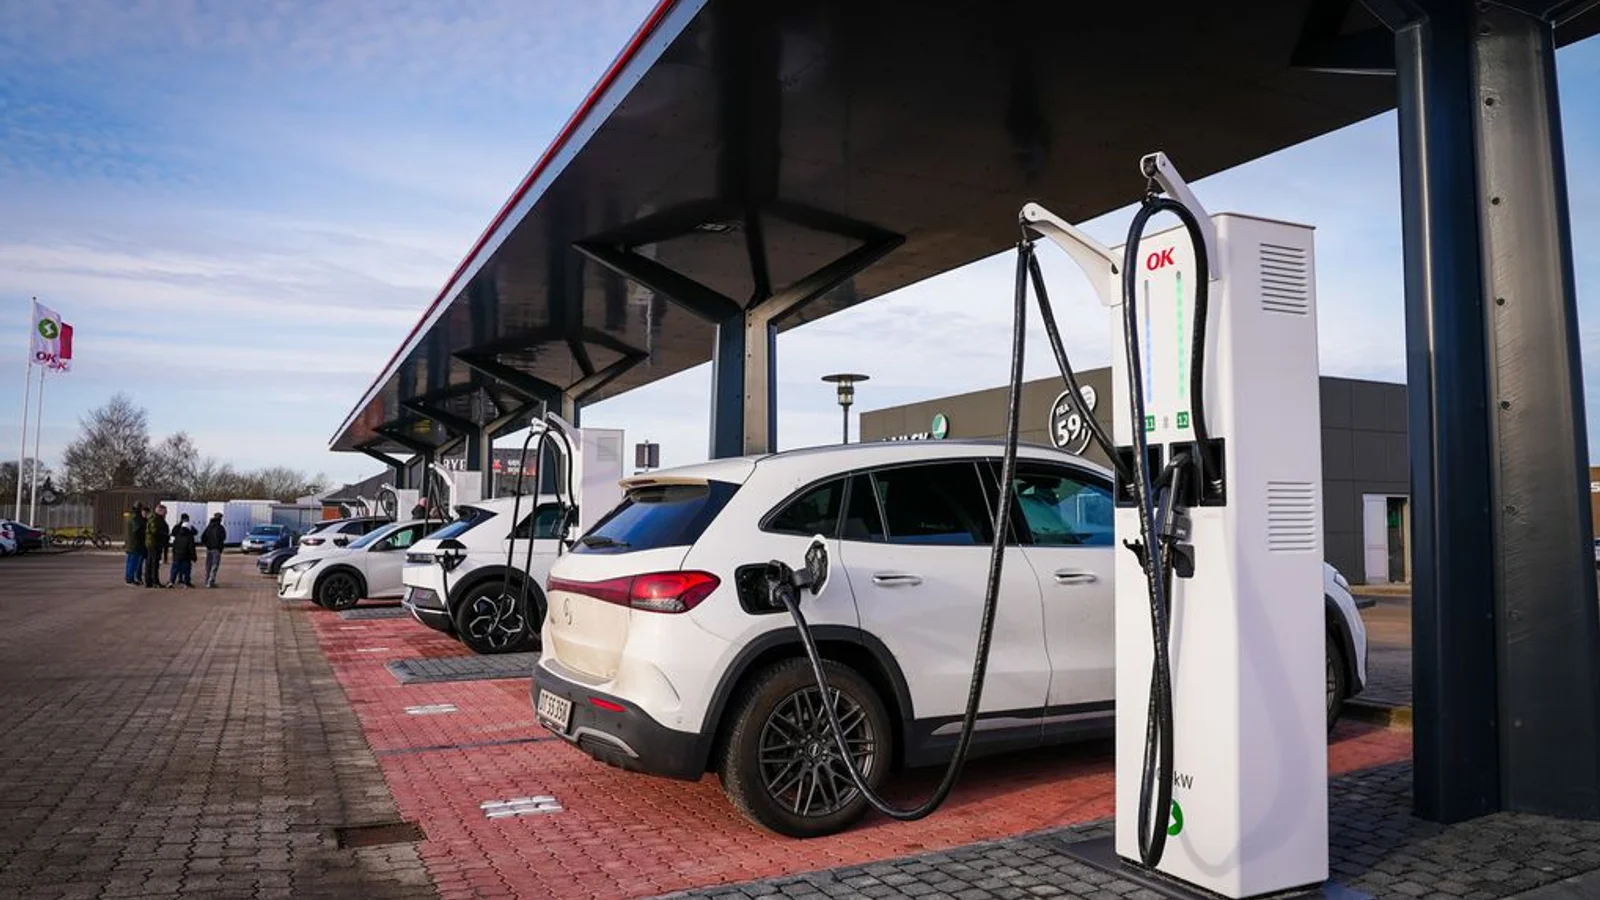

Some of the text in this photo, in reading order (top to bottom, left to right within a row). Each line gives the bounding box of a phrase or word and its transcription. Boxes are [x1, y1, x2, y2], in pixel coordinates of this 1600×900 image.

[1147, 247, 1175, 271] OK
[36, 351, 56, 363] OK
[1174, 770, 1194, 790] kW
